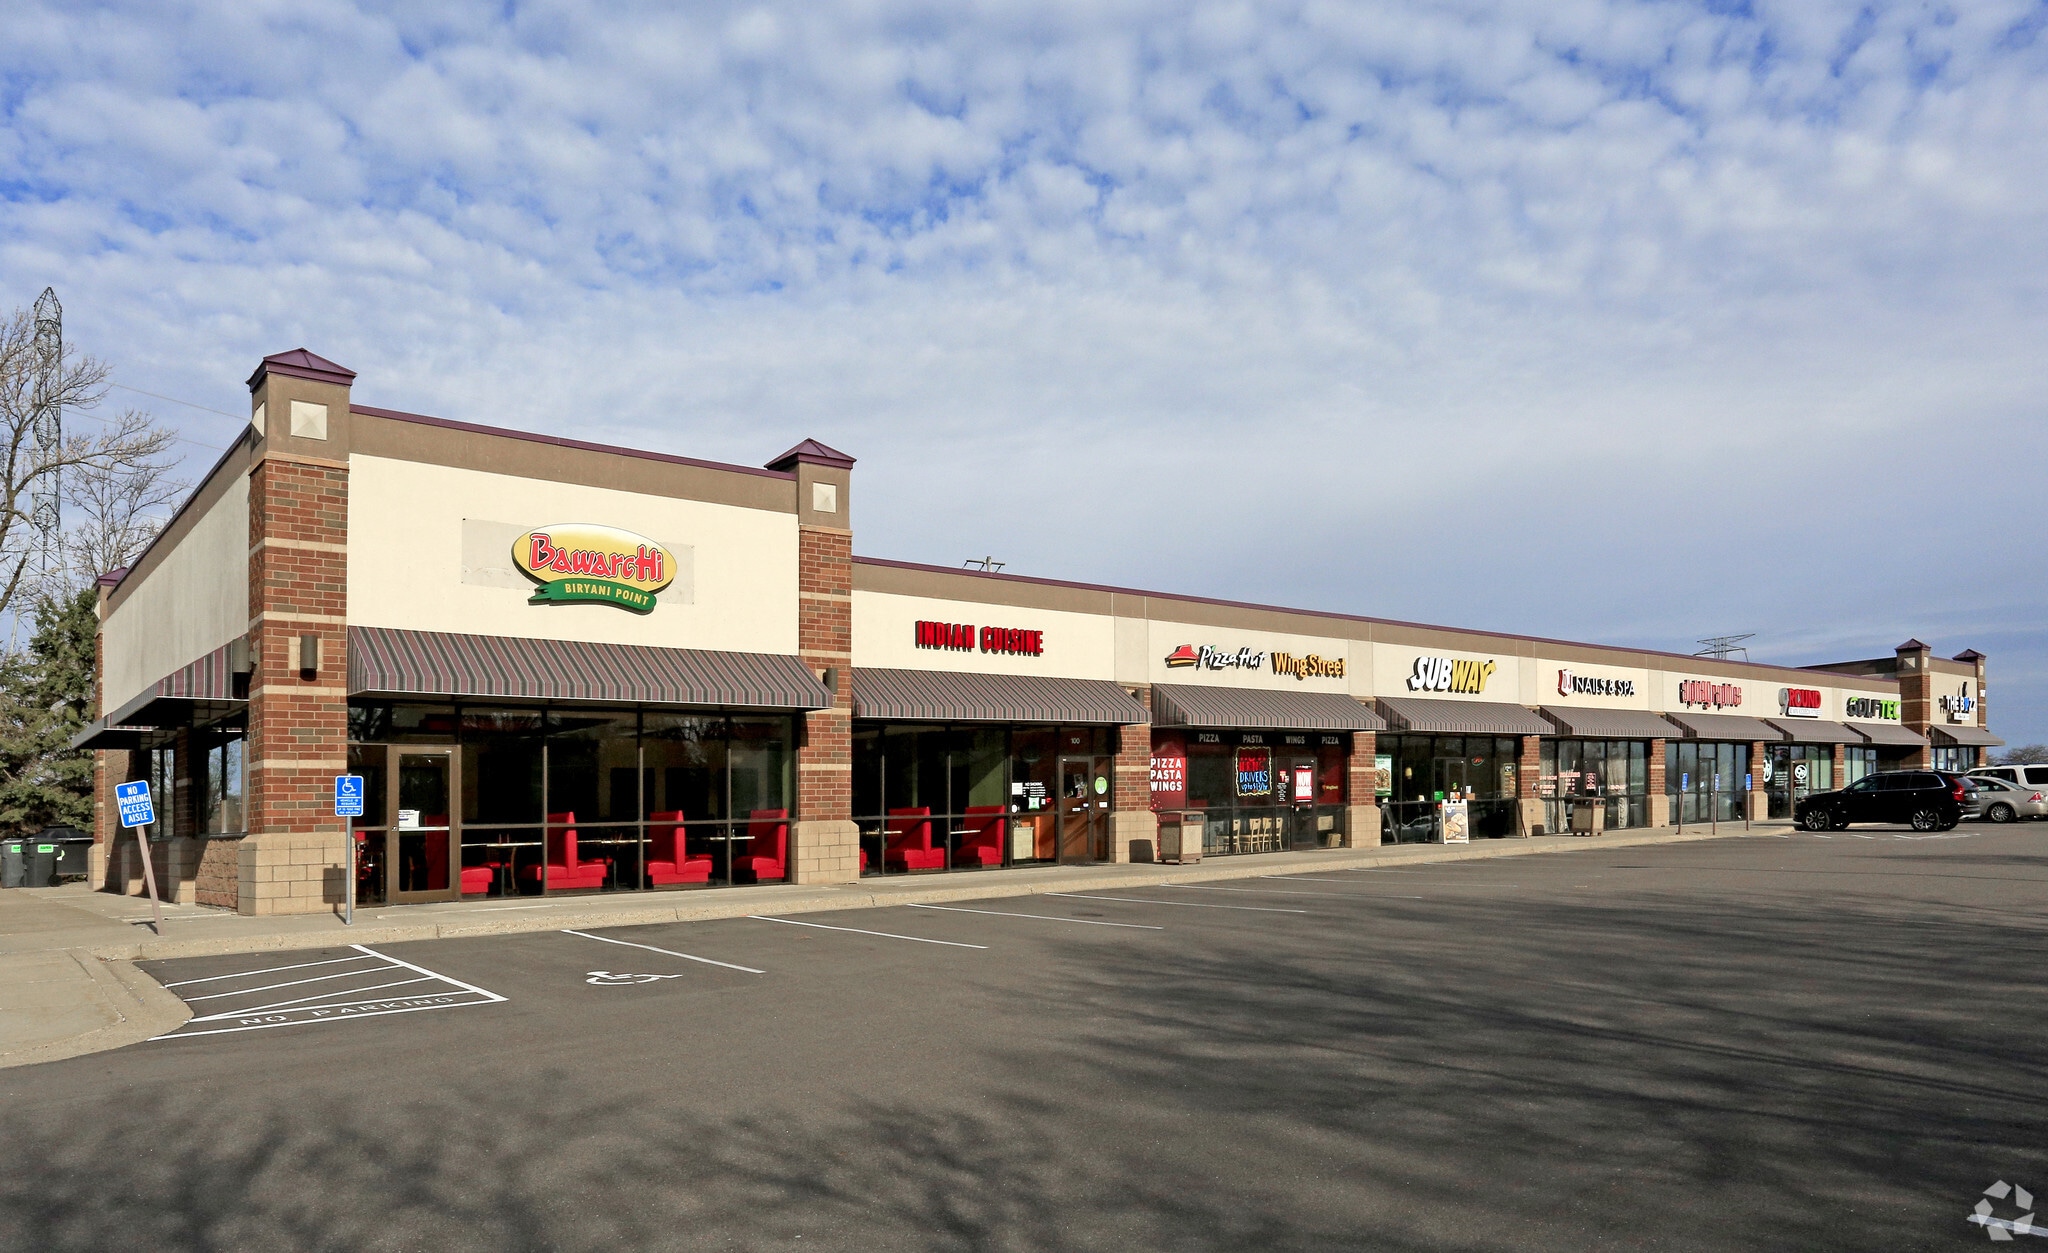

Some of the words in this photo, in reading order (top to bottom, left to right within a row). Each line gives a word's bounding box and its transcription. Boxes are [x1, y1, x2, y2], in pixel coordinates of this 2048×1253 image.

[565, 583, 611, 596] BIRYANI
[615, 588, 649, 606] POINT
[916, 620, 975, 649] INDIAN
[982, 626, 1043, 654] CUISINE
[1409, 656, 1497, 692] SUBWAY
[1576, 678, 1605, 693] NAILS
[1618, 680, 1635, 695] SPA
[1198, 733, 1220, 743] PIZZA
[1242, 734, 1264, 744] PASTA
[1285, 735, 1305, 745] WINGS
[1321, 736, 1340, 745] PIZZA
[1150, 758, 1182, 769] PIZZA
[1150, 769, 1182, 780] PASTA
[1239, 771, 1269, 783] DRIVERS
[127, 786, 138, 795] NO
[1150, 781, 1183, 792] WINGS
[120, 794, 149, 806] PARKING
[123, 802, 150, 815] ACCESS
[128, 812, 149, 823] AISLE
[240, 1015, 287, 1025] NO
[311, 997, 454, 1017] PARKING
